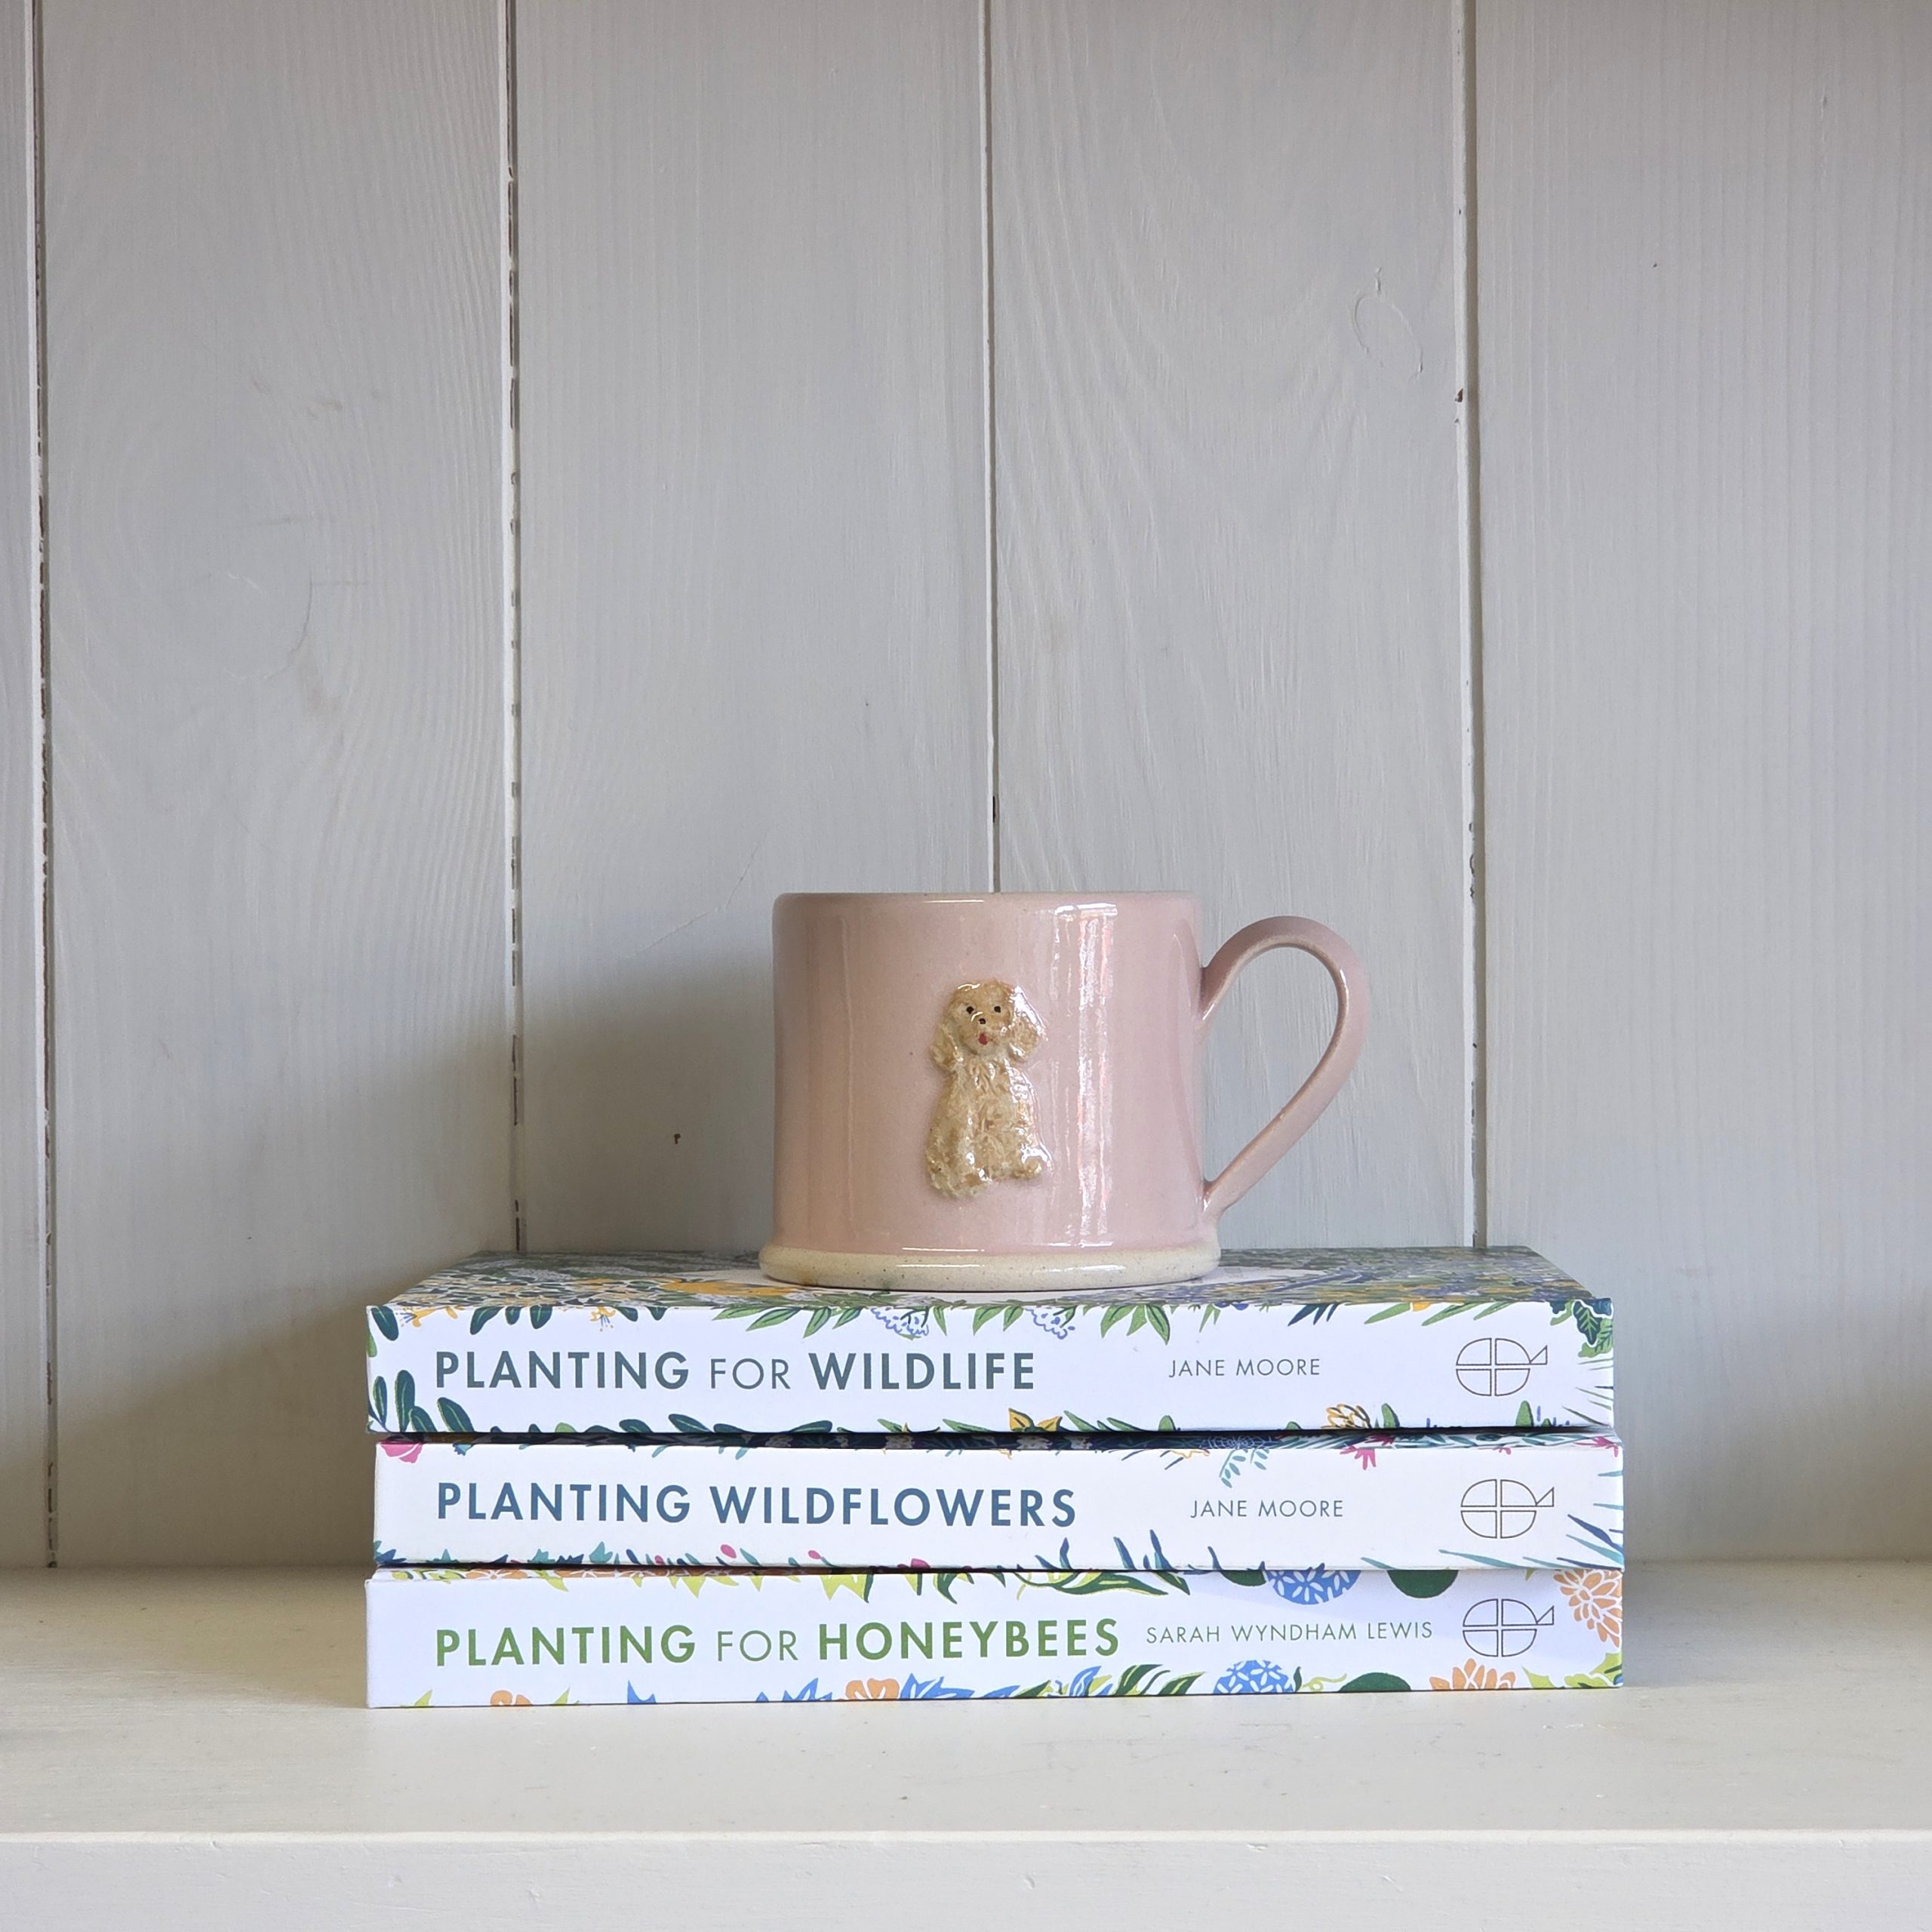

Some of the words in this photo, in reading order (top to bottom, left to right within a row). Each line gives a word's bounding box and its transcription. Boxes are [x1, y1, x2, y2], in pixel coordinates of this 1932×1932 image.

[436, 1351, 688, 1389] PLANTING
[711, 1358, 790, 1389] FOR
[808, 1352, 1033, 1390] WILDLIFE
[1169, 1360, 1224, 1377] JANE
[1236, 1358, 1319, 1376] MOORE
[438, 1482, 690, 1523] PLANTING
[709, 1486, 1075, 1527] WILDFLOWERS
[1190, 1500, 1247, 1518] JANE
[1259, 1500, 1343, 1517] MOORE
[437, 1625, 695, 1666] PLANTING
[718, 1630, 798, 1661] FOR
[820, 1618, 1118, 1660] HONEYBEES
[1147, 1626, 1219, 1643] SARAH
[1232, 1623, 1356, 1641] WYNDHAM
[1368, 1622, 1432, 1639] LEWIS
